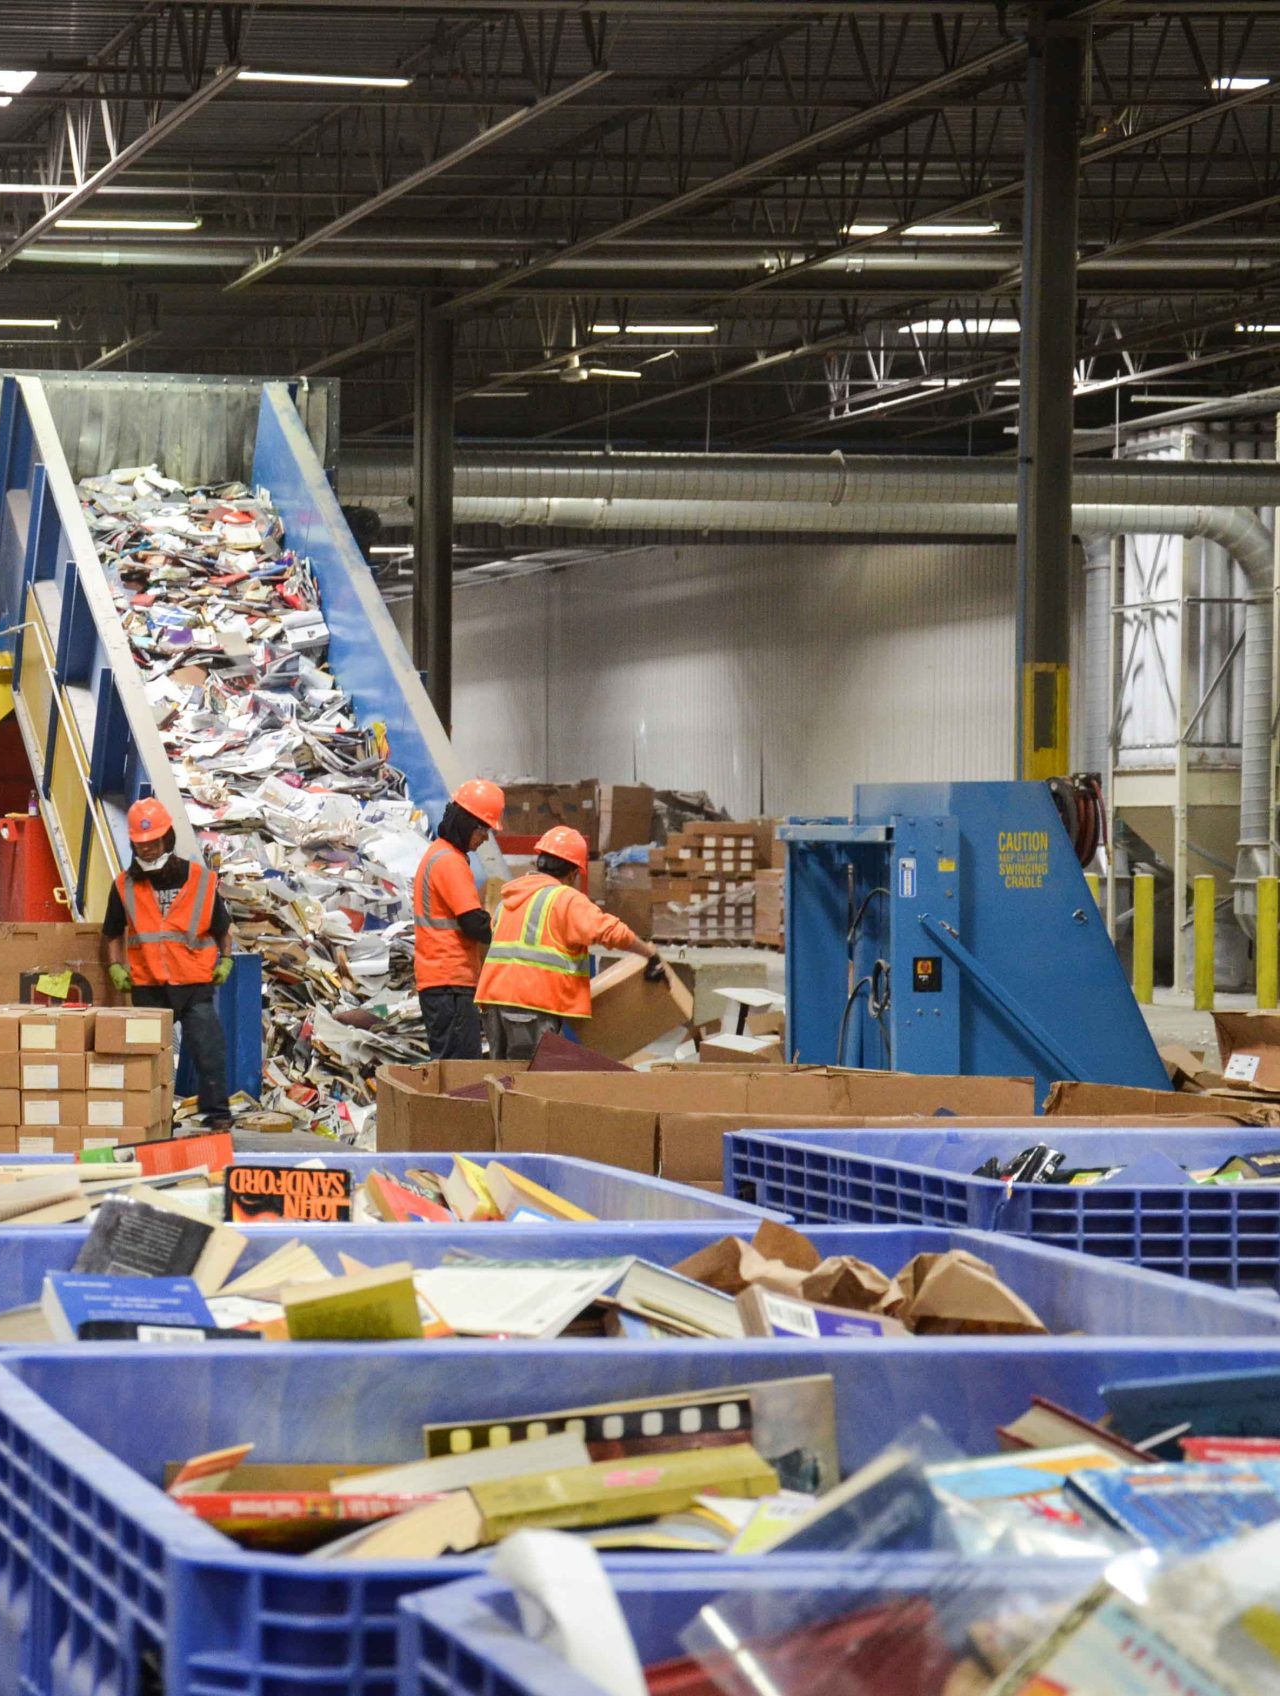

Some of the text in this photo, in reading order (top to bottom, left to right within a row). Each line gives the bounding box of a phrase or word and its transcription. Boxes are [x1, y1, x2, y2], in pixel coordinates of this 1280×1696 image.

[998, 831, 1048, 852] CAUTION
[998, 863, 1048, 876] SWINGING
[1004, 875, 1043, 889] CRADLE
[229, 1167, 345, 1197] SANDFORD
[283, 1194, 352, 1222] JOHN
